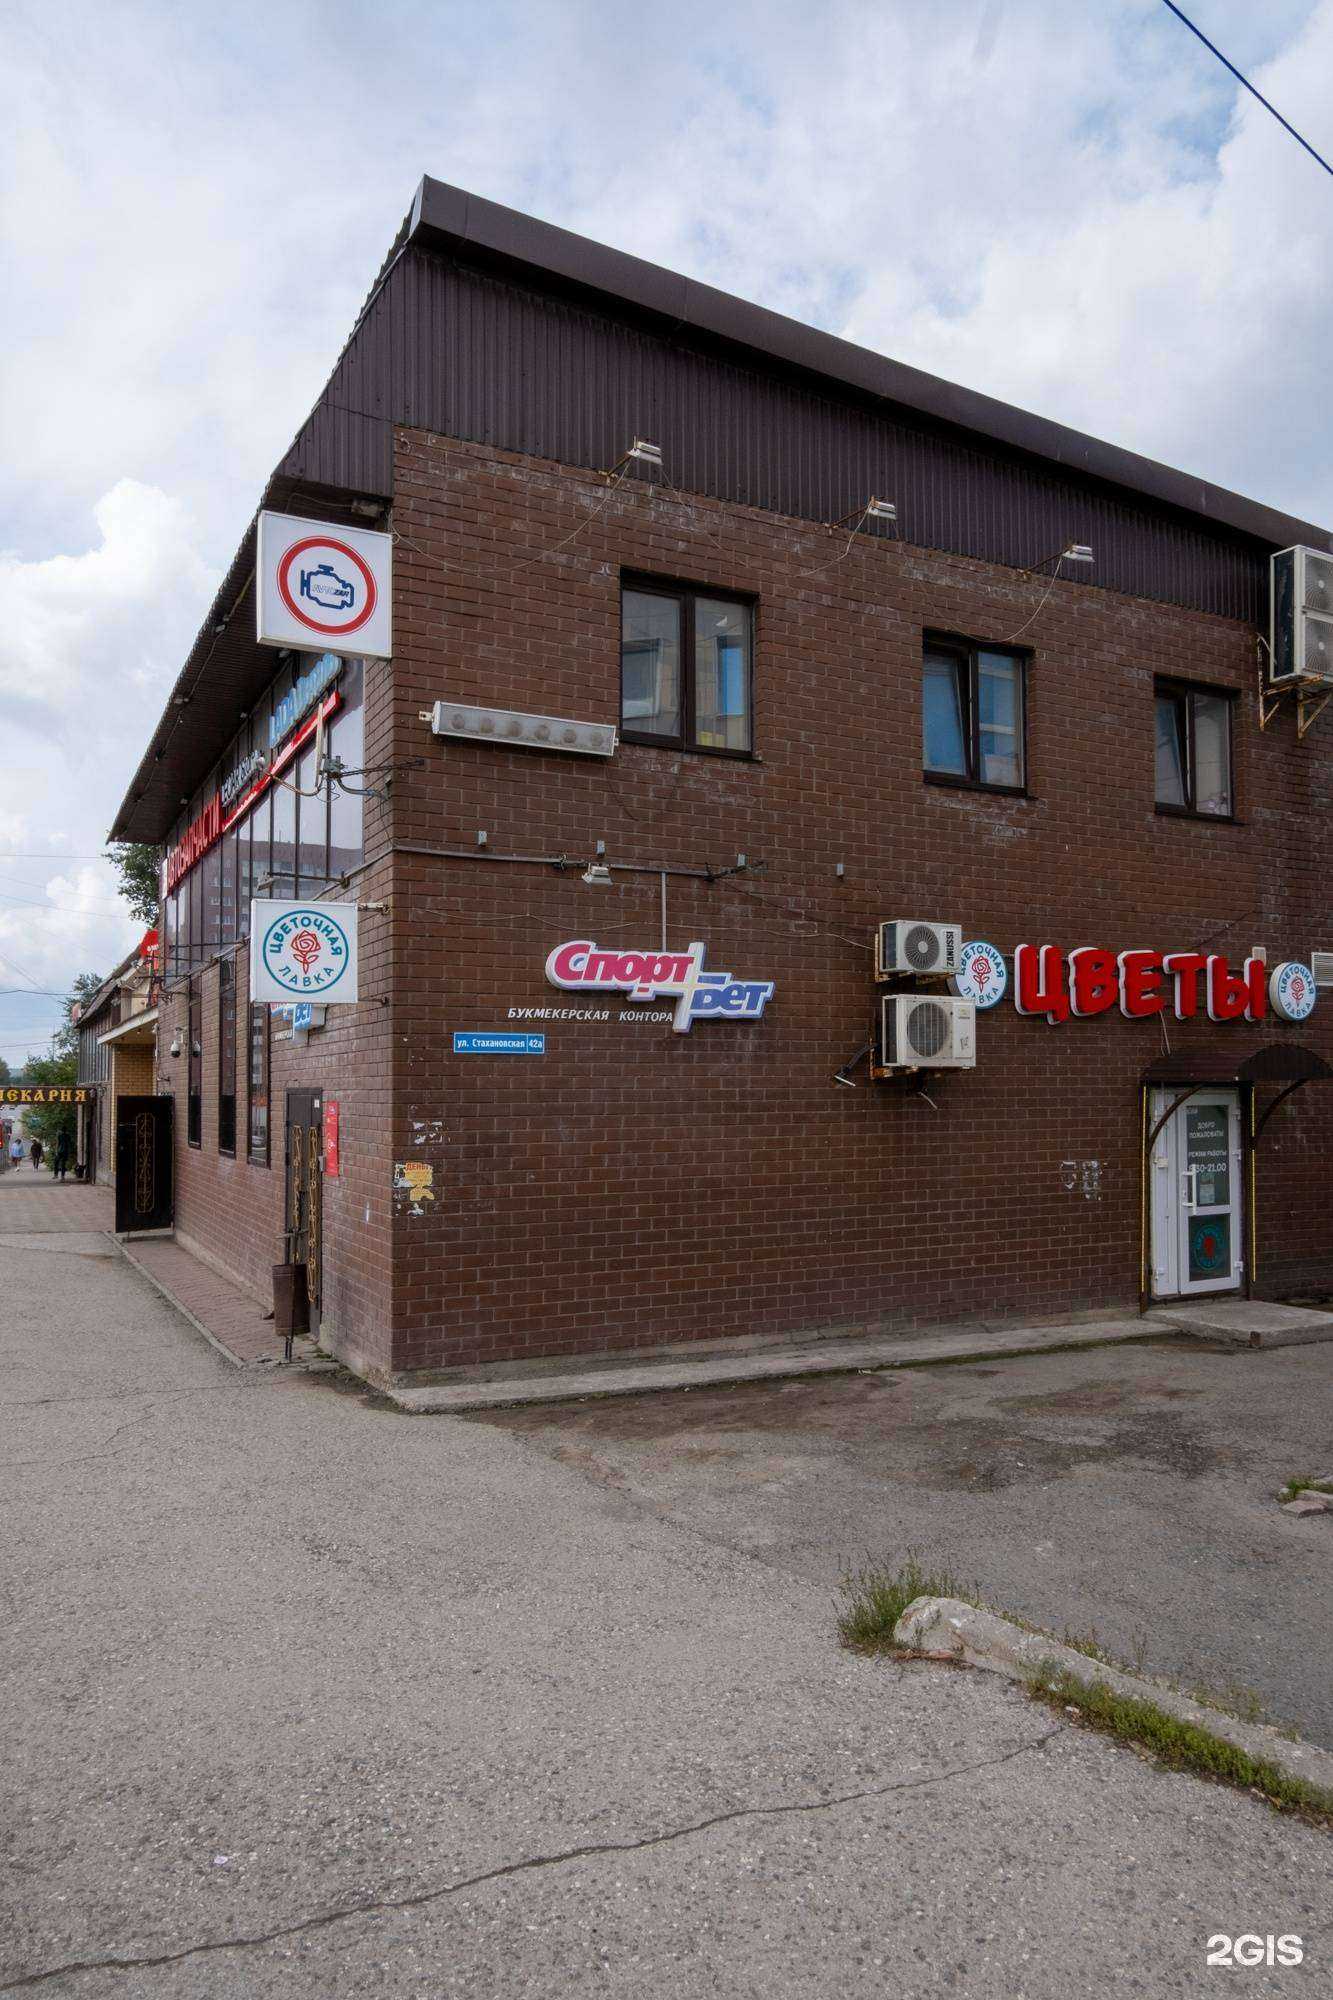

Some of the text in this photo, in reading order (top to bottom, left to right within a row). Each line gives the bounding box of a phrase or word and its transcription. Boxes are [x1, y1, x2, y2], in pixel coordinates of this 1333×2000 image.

[270, 916, 343, 956] ЦВЕТОЧНАЯ
[946, 931, 954, 967] ZANUSSI
[279, 965, 334, 987] ЛАВКА
[553, 943, 694, 993] Спорт
[1280, 966, 1314, 994] ЦВЕТОЧНАЯ
[1014, 943, 1266, 1025] ЦВЕТЫ
[507, 1007, 673, 1022] БУКМЕКЕРСКАЯ КОНТОРА
[1285, 1002, 1311, 1017] ЛАВКА
[457, 1037, 543, 1049] ул. Стахановская 42а
